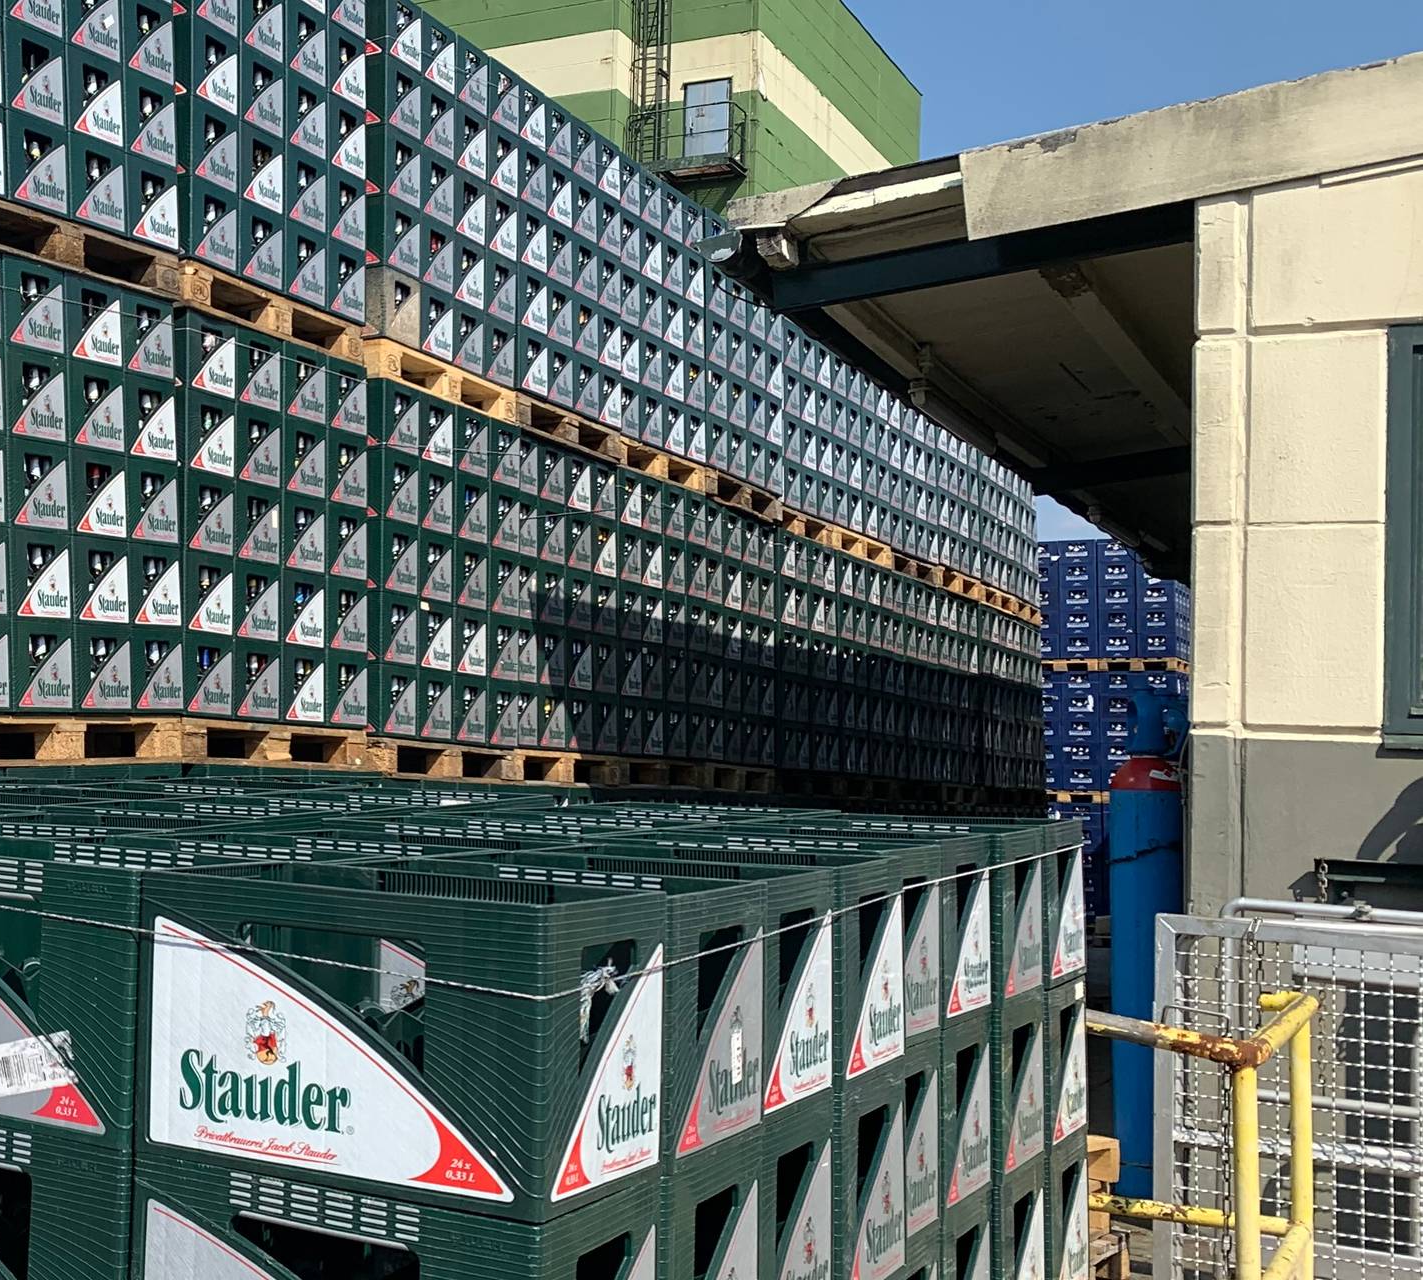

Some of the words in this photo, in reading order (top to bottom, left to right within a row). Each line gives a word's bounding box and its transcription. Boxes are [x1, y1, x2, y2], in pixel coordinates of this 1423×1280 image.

[28, 1, 60, 27] Stauder
[90, 26, 117, 51] Stauder
[146, 50, 171, 74] Stauder
[31, 87, 61, 113] Stauder
[92, 111, 120, 135] Stauder
[148, 132, 173, 155] Stauder
[35, 177, 63, 201] Stauder
[94, 197, 122, 220] Stauder
[150, 216, 176, 238] Stauder
[31, 319, 61, 341] Stauder
[91, 334, 119, 355] Stauder
[145, 348, 170, 368] Stauder
[32, 409, 63, 429] Stauder
[93, 420, 121, 440] Stauder
[147, 431, 173, 449] Stauder
[34, 499, 65, 518] Stauder
[96, 508, 124, 526] Stauder
[149, 515, 175, 533] Stauder
[37, 589, 67, 608] Stauder
[98, 594, 126, 613] Stauder
[152, 599, 178, 617] Stauder
[39, 680, 69, 699] Stauder
[100, 681, 128, 700] Stauder
[155, 683, 180, 701] Stauder
[905, 972, 937, 1016] Stauder
[869, 995, 901, 1047] Stauder
[789, 1021, 828, 1077] Stauder
[59, 1095, 69, 1105] 24
[179, 1048, 351, 1134] Stauder
[597, 1083, 657, 1153] Stauder
[194, 1125, 263, 1150] Privatbrauerei
[263, 1137, 293, 1152] Jacob
[293, 1142, 337, 1161] Stauder
[450, 1158, 463, 1169] 24
[866, 1210, 903, 1264] Stauder
